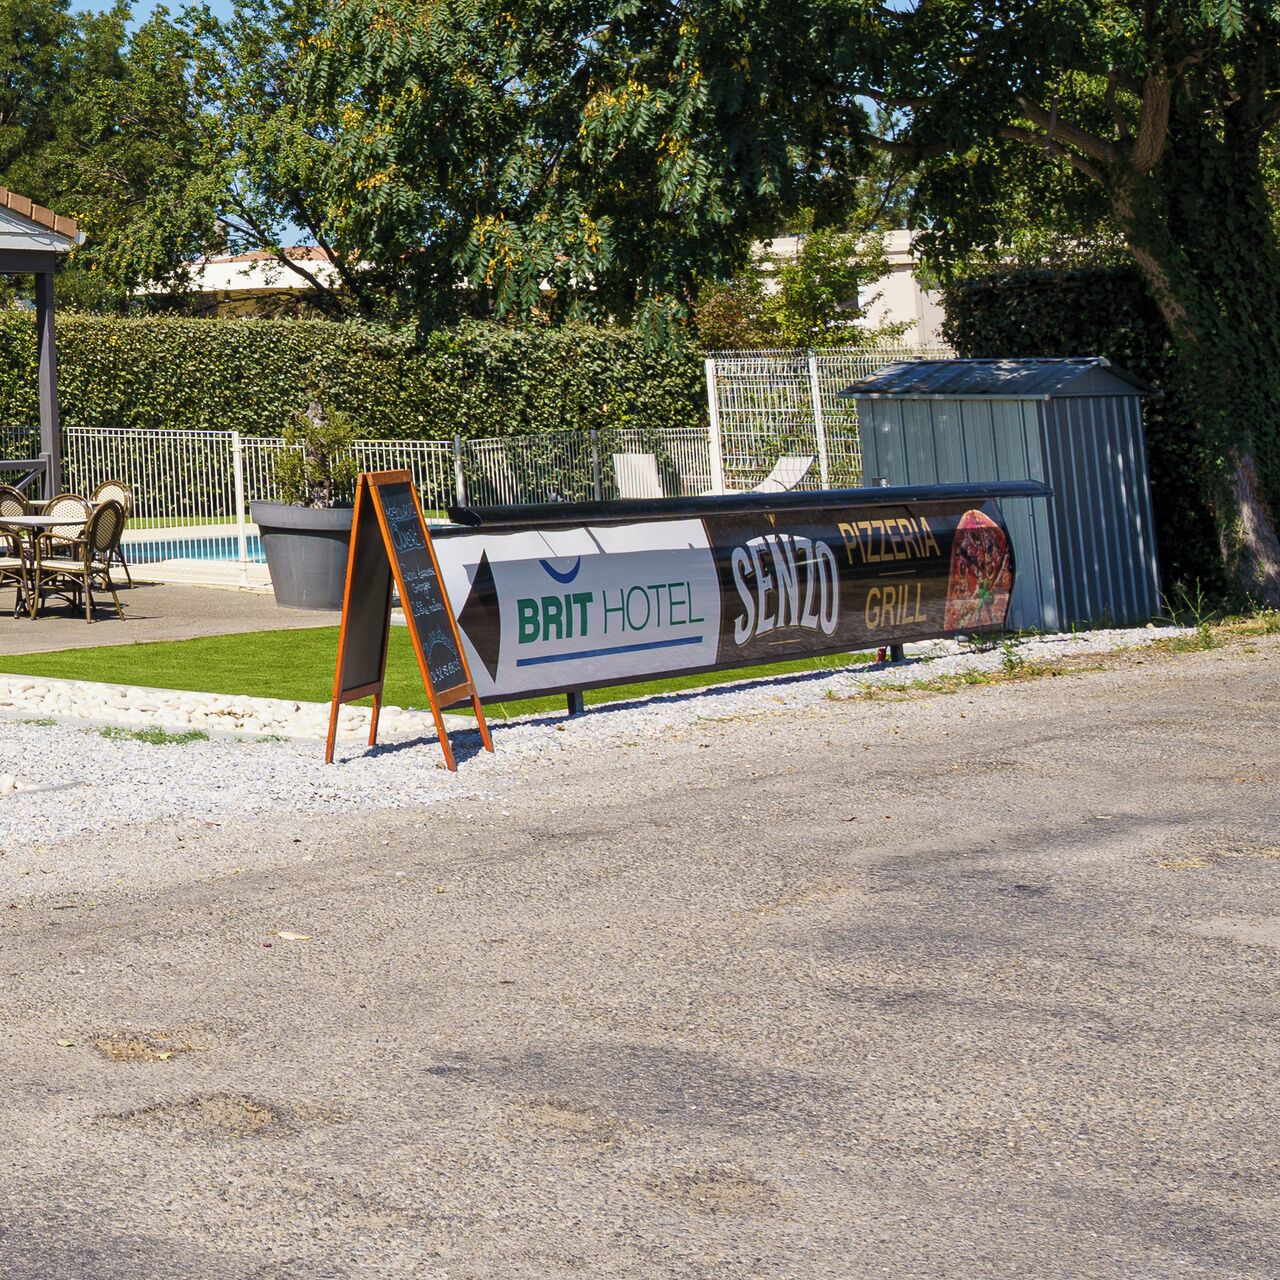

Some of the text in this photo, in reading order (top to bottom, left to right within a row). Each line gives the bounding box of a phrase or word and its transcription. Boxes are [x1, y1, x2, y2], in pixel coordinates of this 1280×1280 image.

[837, 516, 941, 565] PIZZERIA
[517, 591, 594, 645] BRIT
[602, 581, 705, 634] HOTEL
[731, 532, 841, 648] SENZO
[864, 582, 928, 631] GRILL
